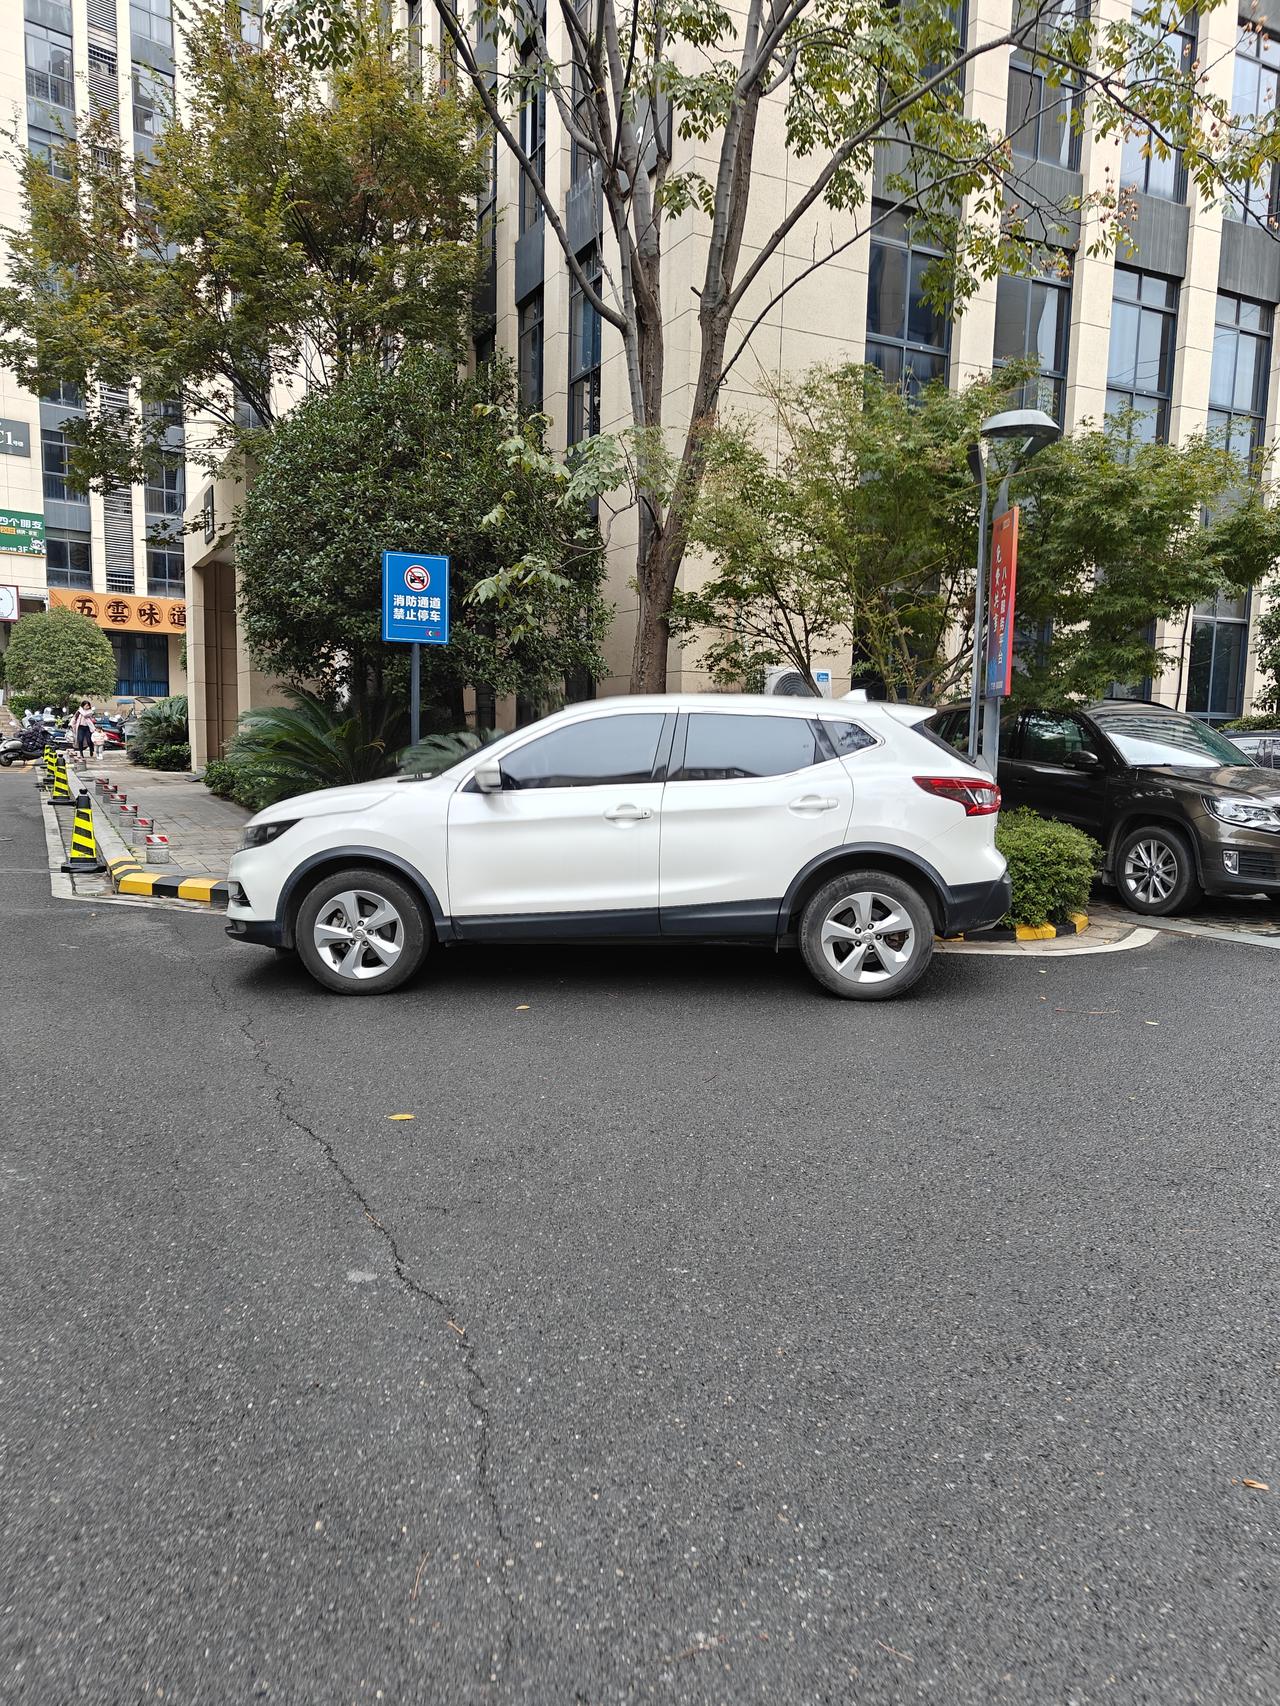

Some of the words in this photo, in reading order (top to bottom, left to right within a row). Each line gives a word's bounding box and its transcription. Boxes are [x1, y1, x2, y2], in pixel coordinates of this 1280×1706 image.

[393, 594, 441, 609] 消防通道
[75, 598, 186, 626] 五雲味道
[393, 608, 441, 622] 禁止停车
